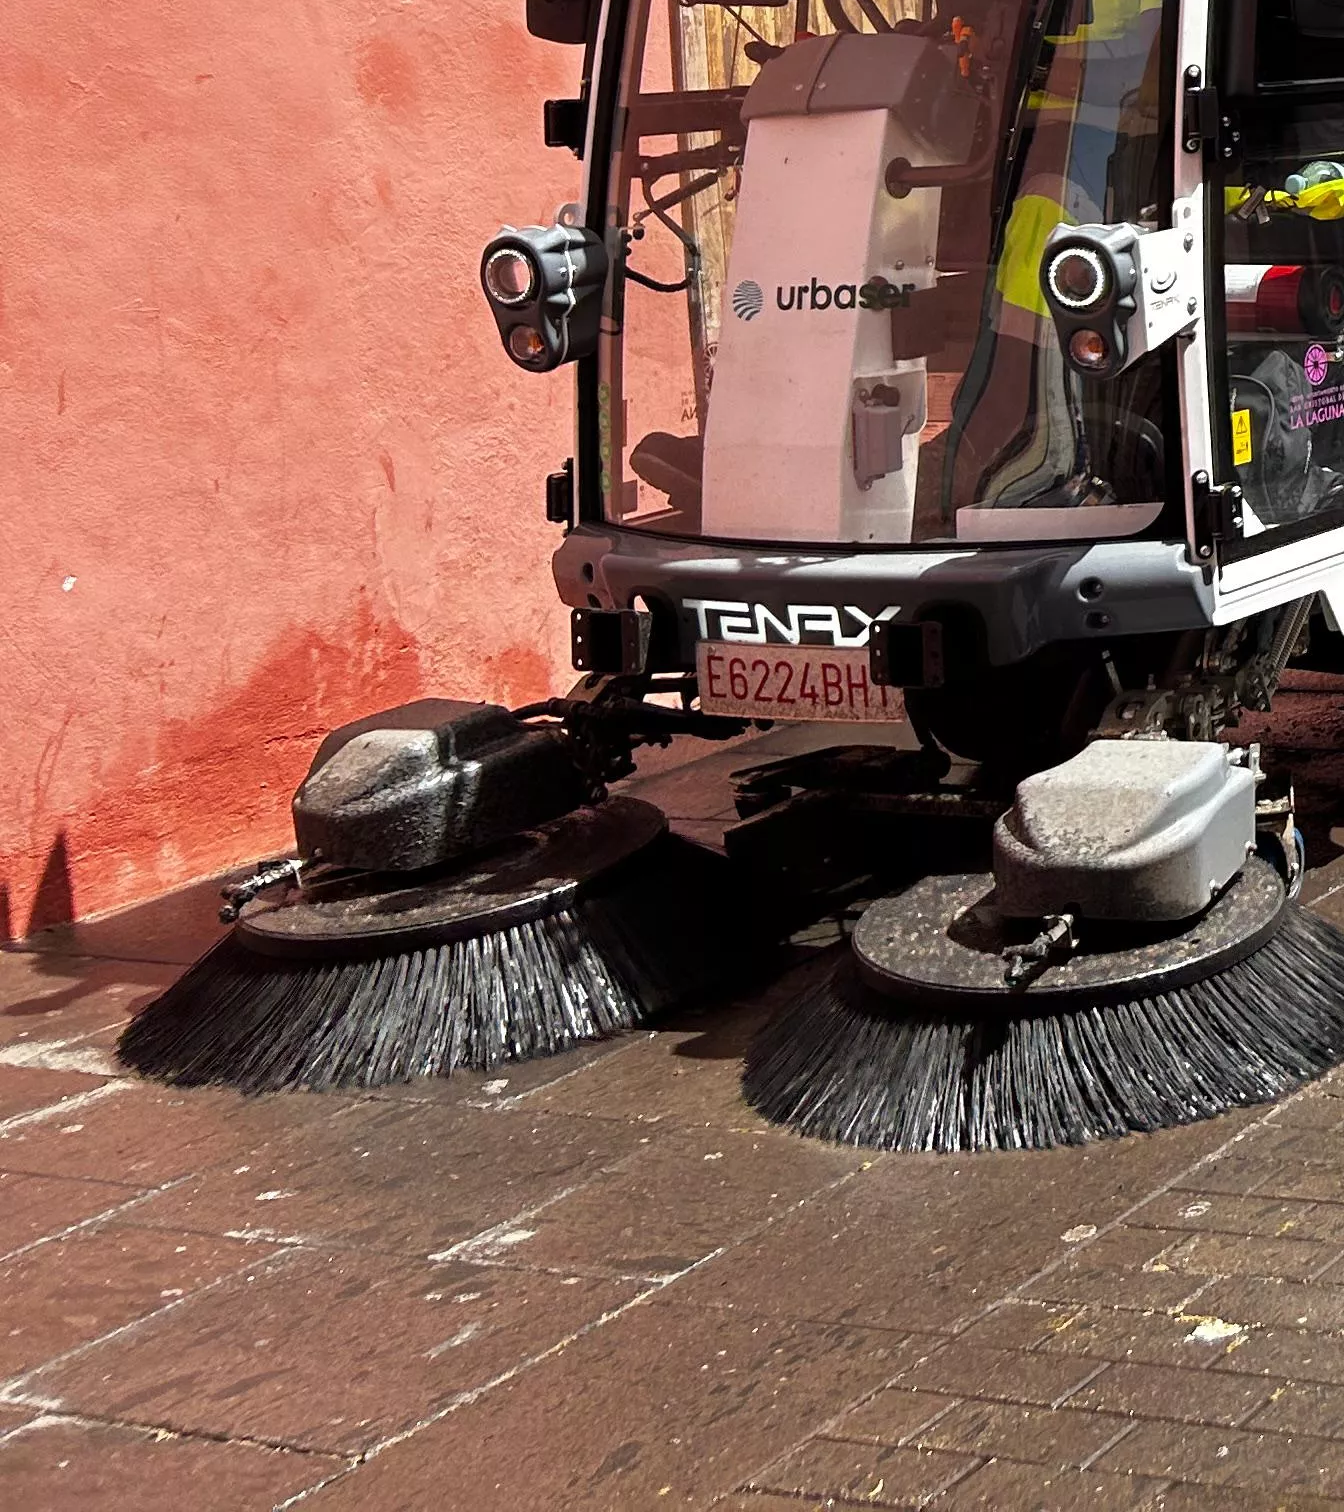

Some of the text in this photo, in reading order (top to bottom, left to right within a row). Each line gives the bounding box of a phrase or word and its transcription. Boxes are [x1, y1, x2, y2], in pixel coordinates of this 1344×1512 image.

[776, 276, 917, 311] urbaser
[1290, 412, 1305, 430] LA
[682, 598, 902, 648] TENAX
